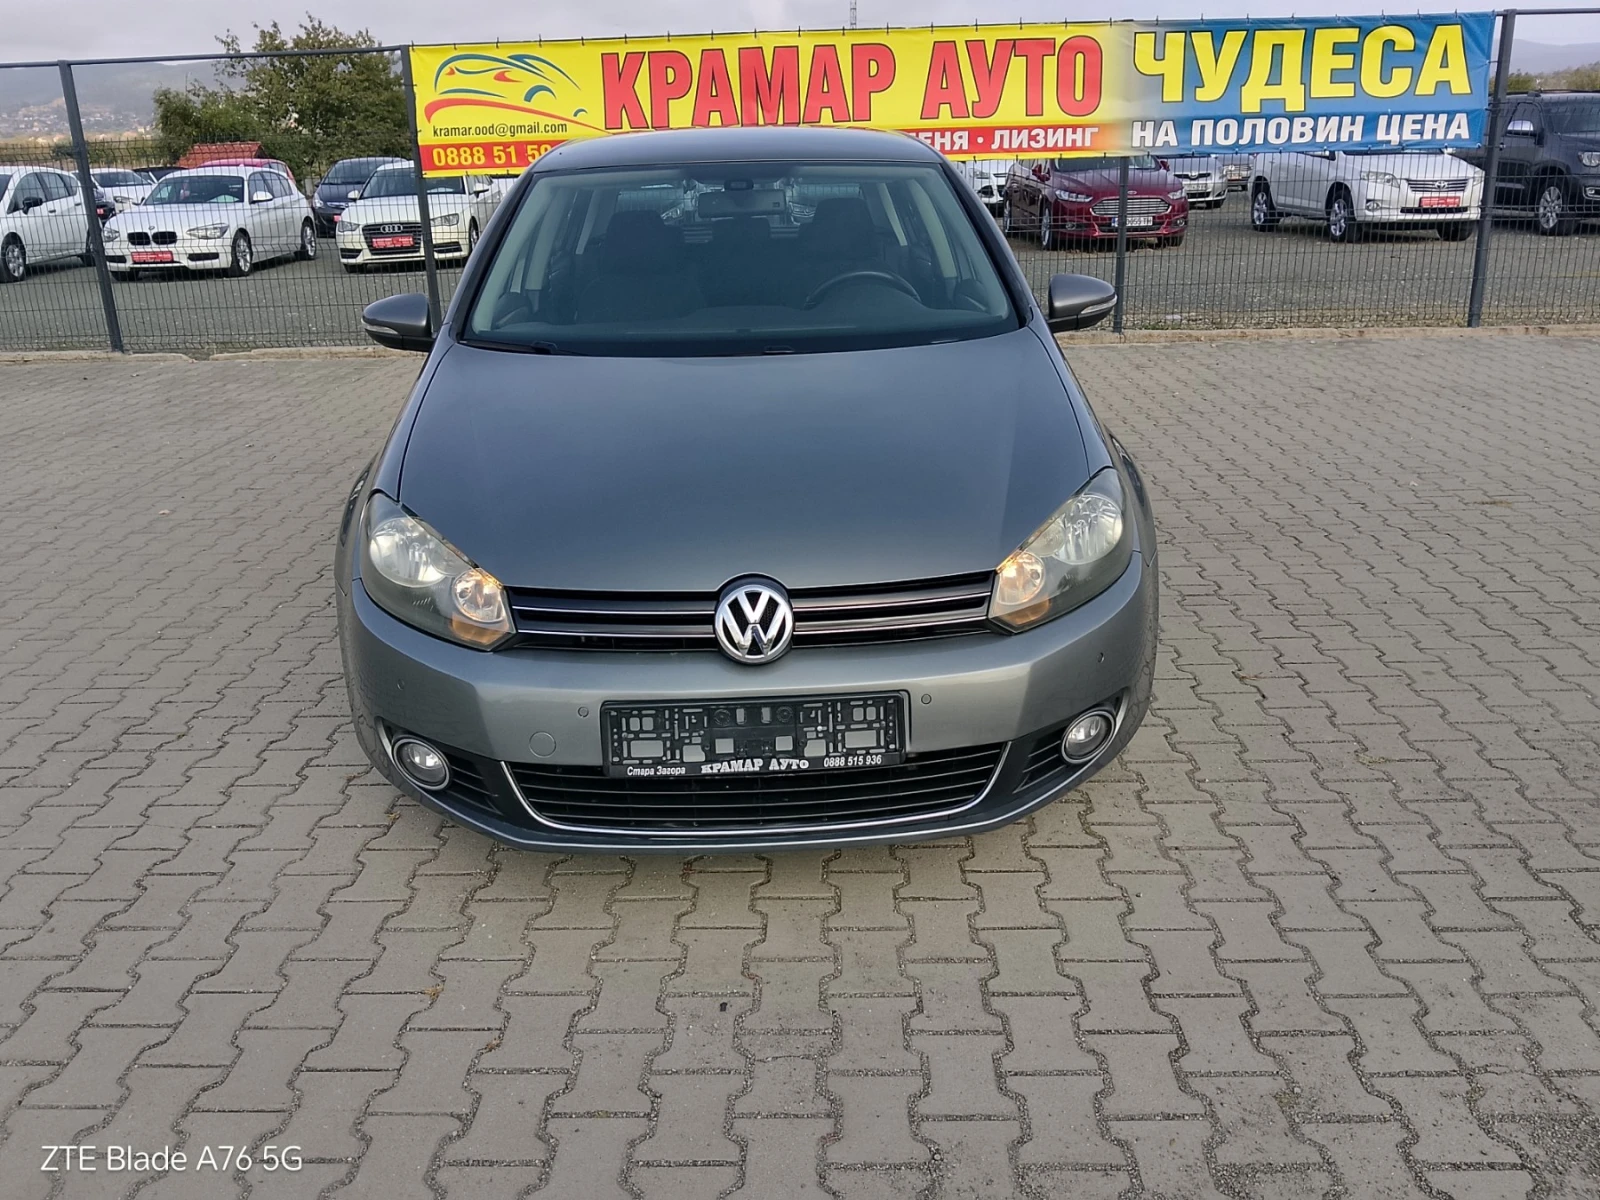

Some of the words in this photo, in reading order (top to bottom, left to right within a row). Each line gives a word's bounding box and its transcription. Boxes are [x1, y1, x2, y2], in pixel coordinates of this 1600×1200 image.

[1133, 24, 1472, 113] ЧУДЕСА
[601, 42, 897, 130] КРАМАР
[920, 35, 1103, 120] АУТО
[433, 121, 568, 138] kramar.ood@gmail.com
[908, 130, 969, 151] ЕНЯ
[990, 127, 1099, 150] ЛИЗИНГ
[1131, 120, 1178, 147] НА
[1190, 115, 1364, 146] ПОЛОВИН
[1375, 113, 1470, 146] ЦЕНА
[432, 146, 486, 166] 0888
[493, 145, 518, 164] 51
[701, 758, 763, 774] КРАМАР
[768, 759, 809, 771] АУТО
[823, 757, 846, 768] 0888
[847, 756, 864, 766] 515
[866, 755, 882, 765] 936
